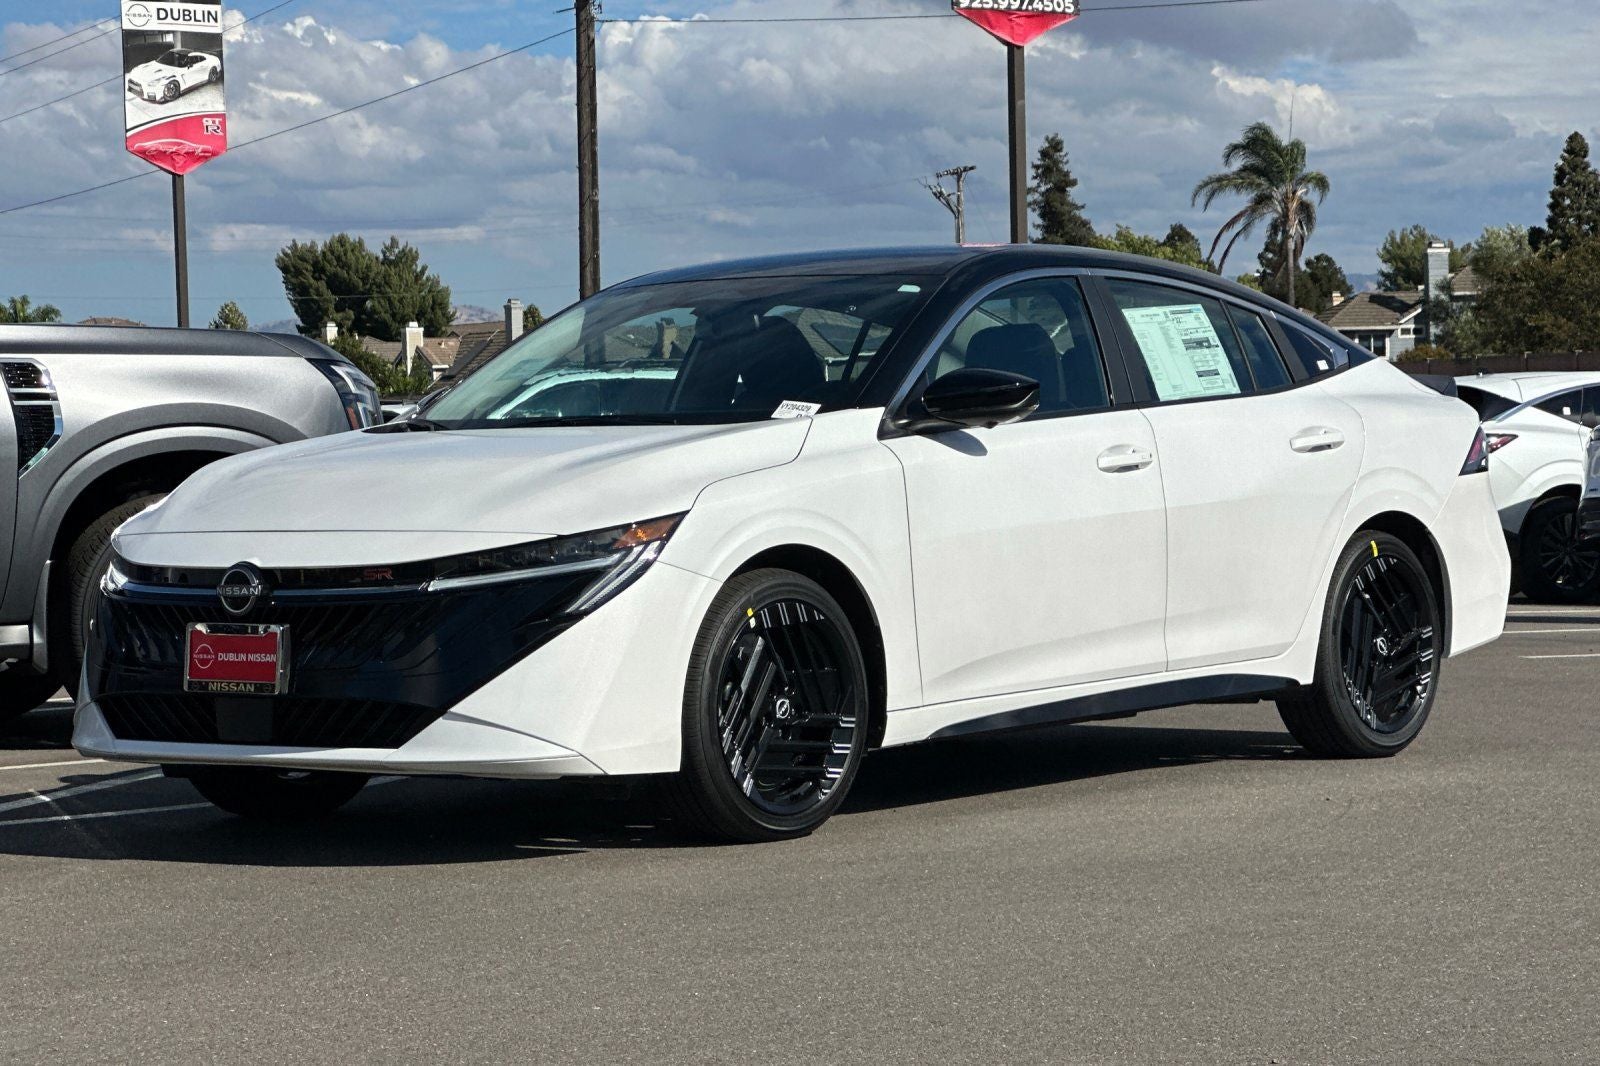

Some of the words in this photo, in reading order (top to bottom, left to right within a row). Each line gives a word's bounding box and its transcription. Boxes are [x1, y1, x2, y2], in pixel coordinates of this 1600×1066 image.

[156, 7, 218, 23] DUBLIN
[364, 567, 394, 581] SR
[216, 586, 259, 596] NISSAN
[218, 652, 247, 662] DUBLIN
[247, 653, 277, 663] NISSAN
[208, 681, 255, 693] NISSAN
